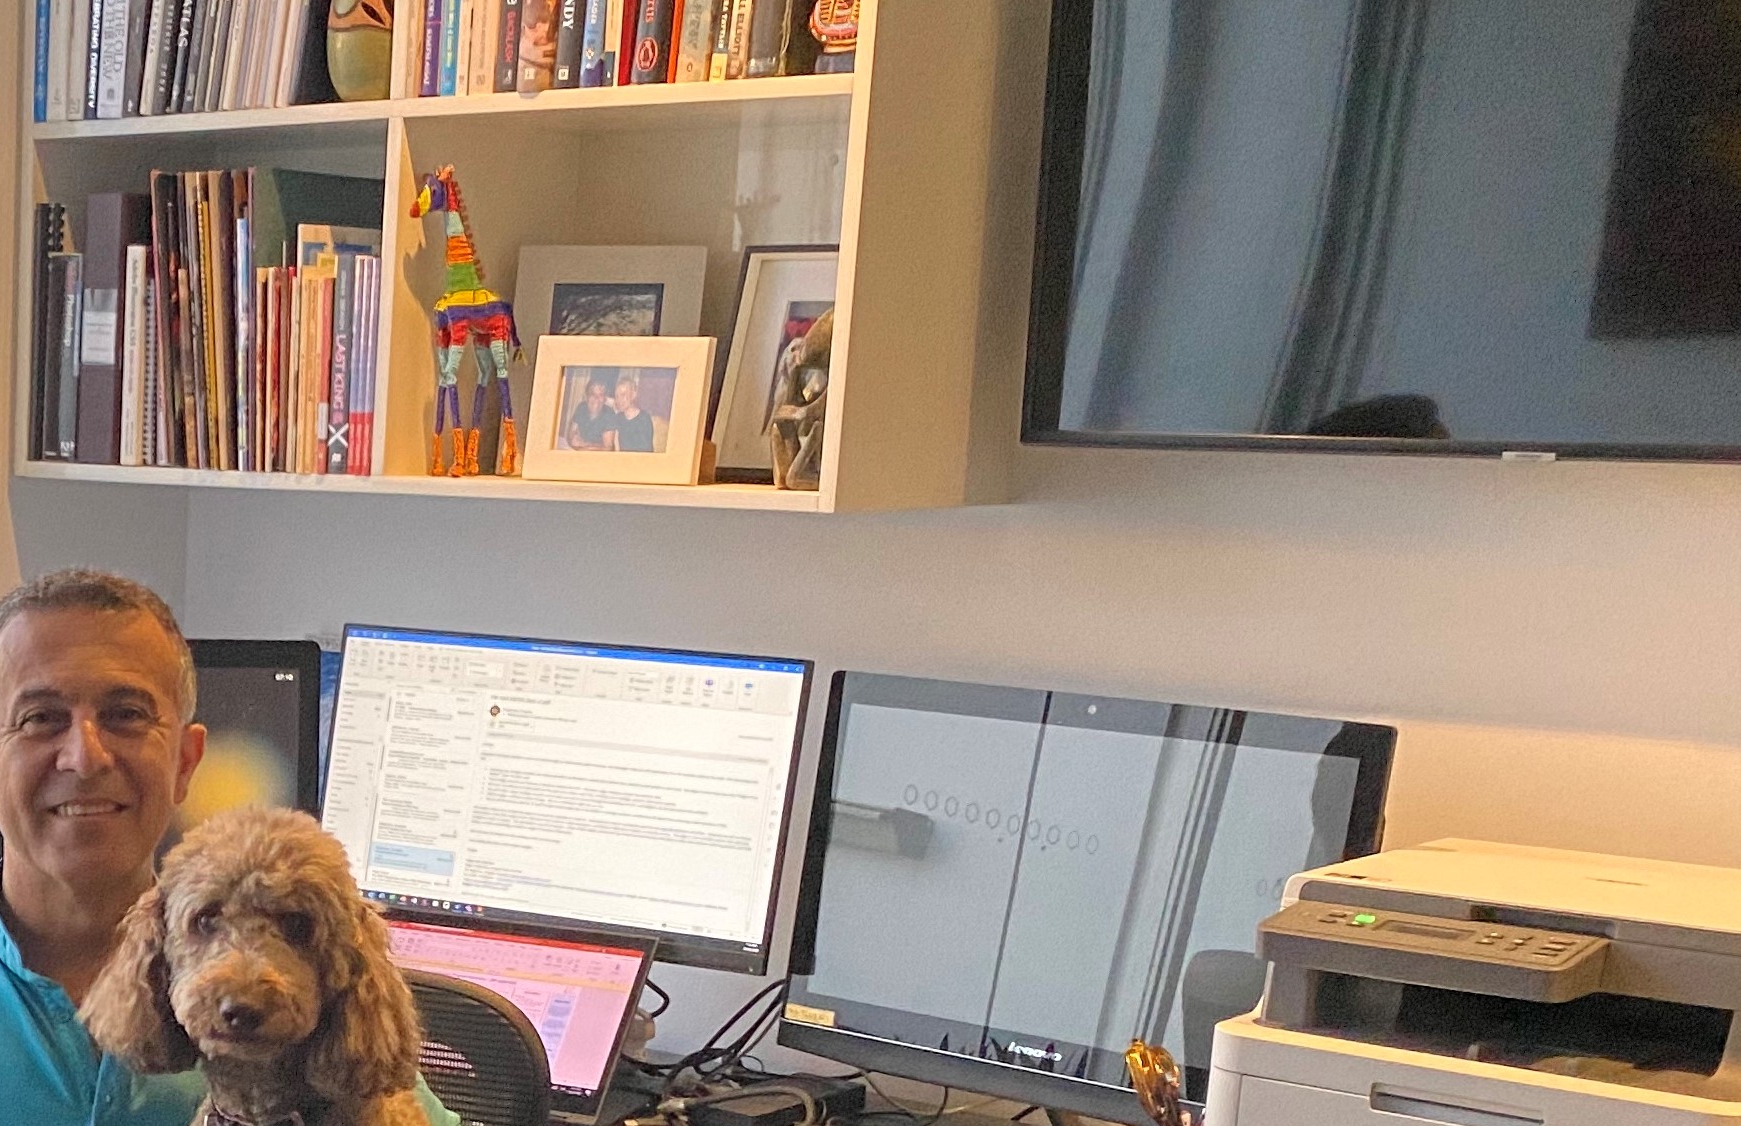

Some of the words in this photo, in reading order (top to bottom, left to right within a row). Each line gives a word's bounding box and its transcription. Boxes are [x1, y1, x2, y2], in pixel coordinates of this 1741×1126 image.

[104, 11, 115, 39] THE
[114, 9, 126, 38] THE
[731, 13, 745, 56] ELLIOTT
[103, 42, 113, 80] NEW
[113, 40, 124, 73] OLD
[88, 52, 98, 108] DIVERSITY
[64, 294, 74, 347] Photoshop
[334, 333, 347, 372] LAST
[333, 373, 345, 410] KING
[327, 422, 349, 448] X
